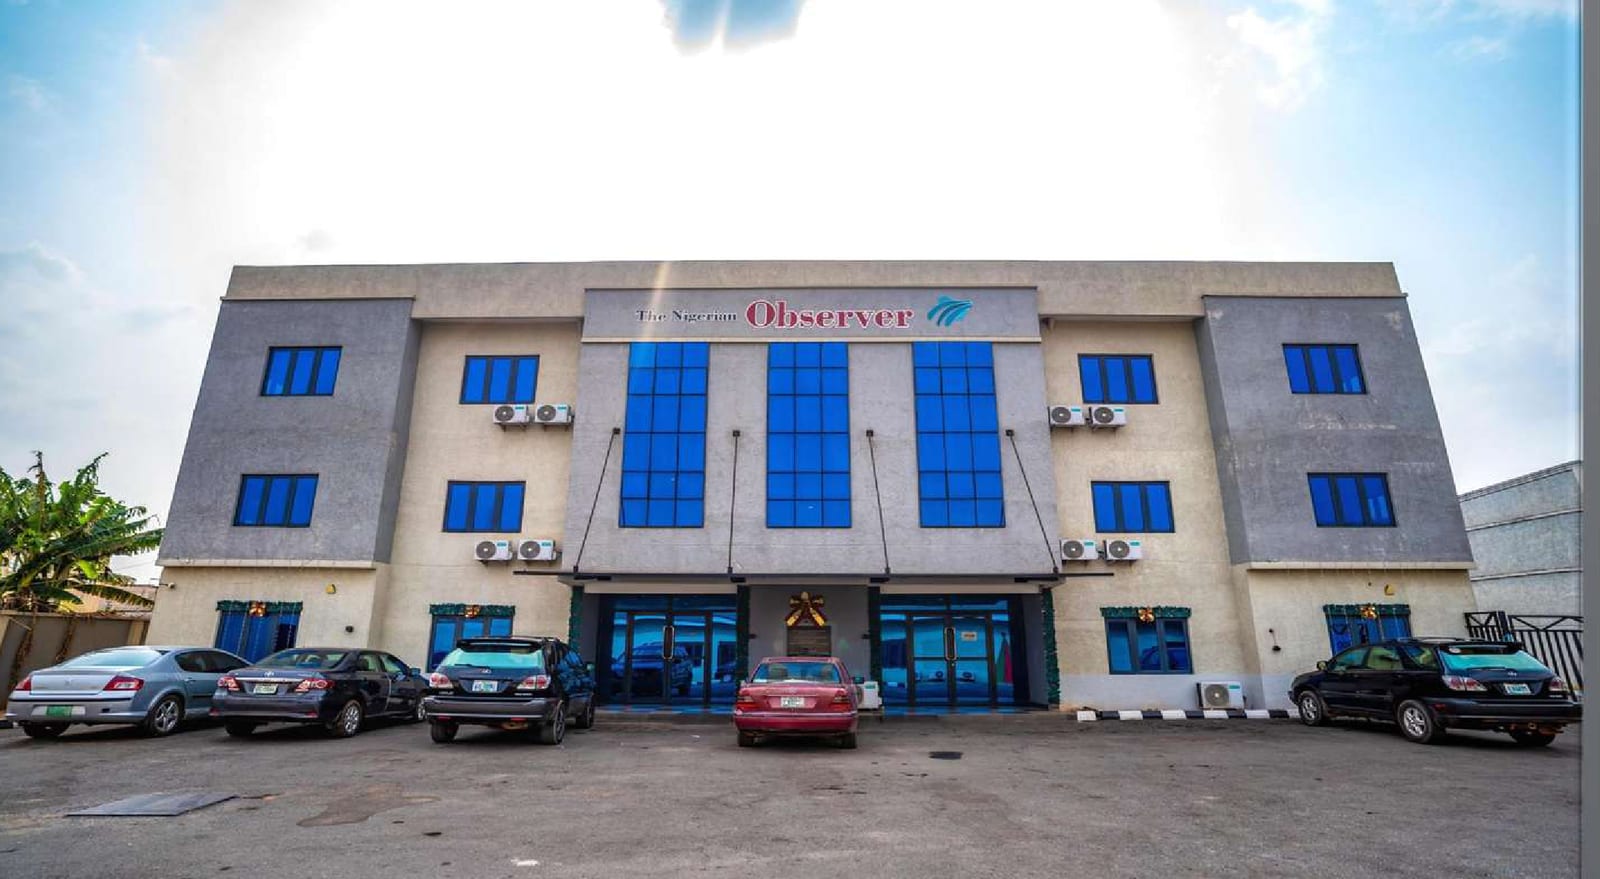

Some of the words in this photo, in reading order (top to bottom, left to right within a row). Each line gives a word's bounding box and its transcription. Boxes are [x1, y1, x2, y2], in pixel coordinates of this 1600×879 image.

[637, 310, 667, 322] The
[673, 309, 737, 323] Nigerian
[745, 298, 914, 329] Observer
